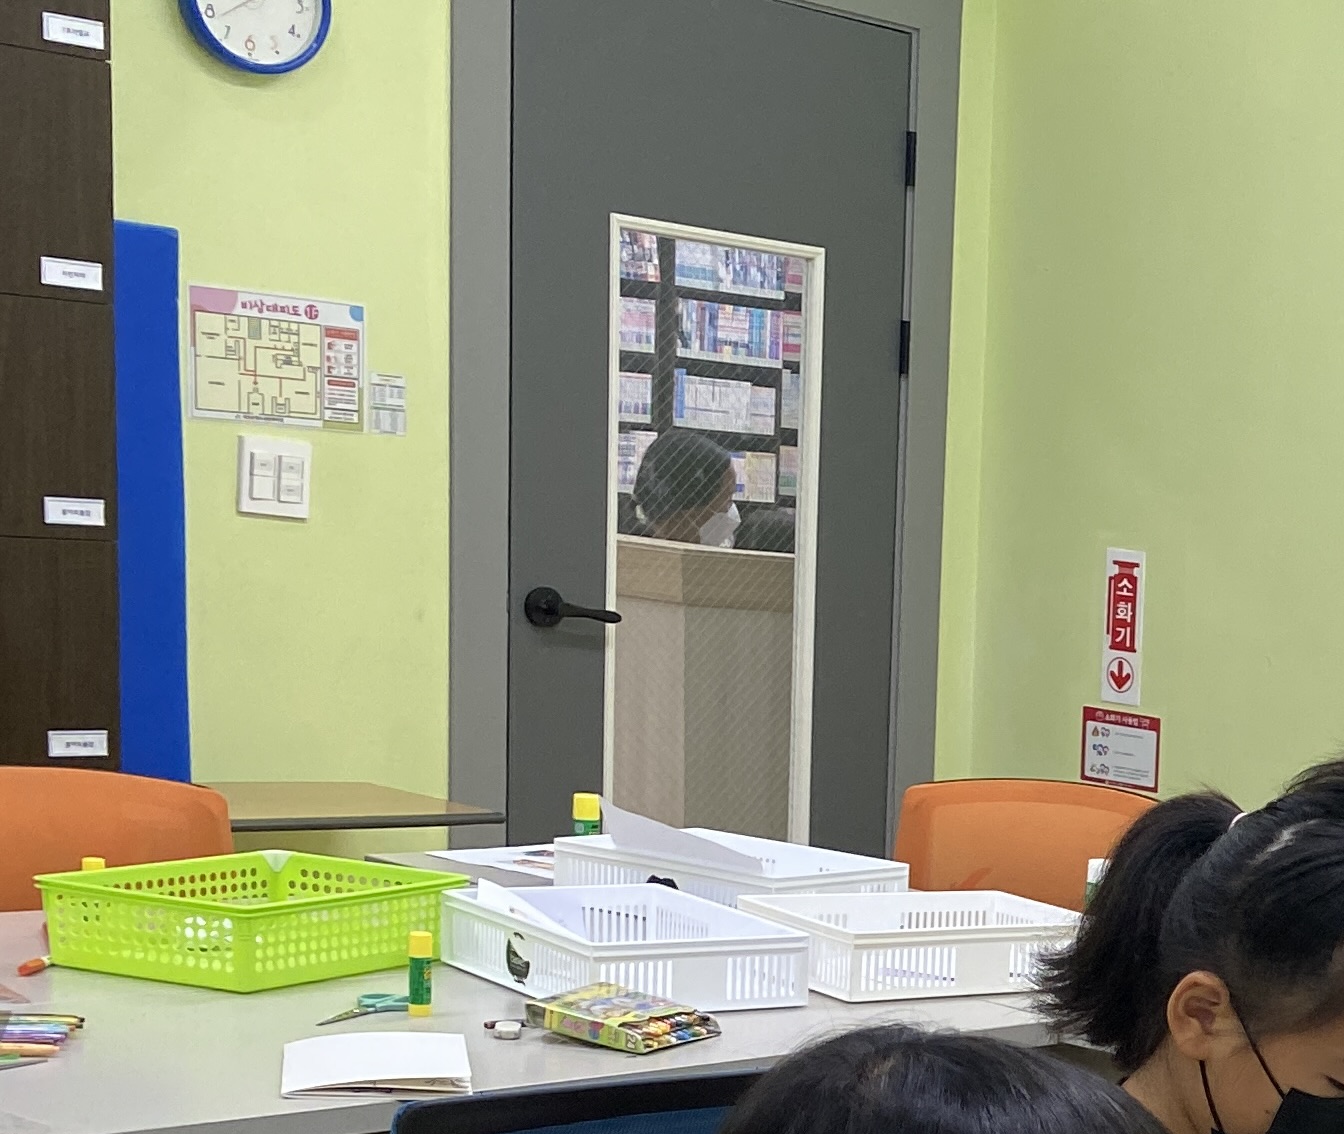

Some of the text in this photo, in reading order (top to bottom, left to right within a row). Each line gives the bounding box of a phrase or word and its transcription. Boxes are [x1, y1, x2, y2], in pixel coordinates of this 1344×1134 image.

[204, 3, 215, 19] 8
[288, 24, 296, 37] 4
[244, 34, 255, 51] 6
[240, 299, 302, 317] 비상대피도
[1115, 577, 1134, 648] 소화기
[1105, 713, 1122, 724] 소화기
[1122, 716, 1139, 727] 사용법
